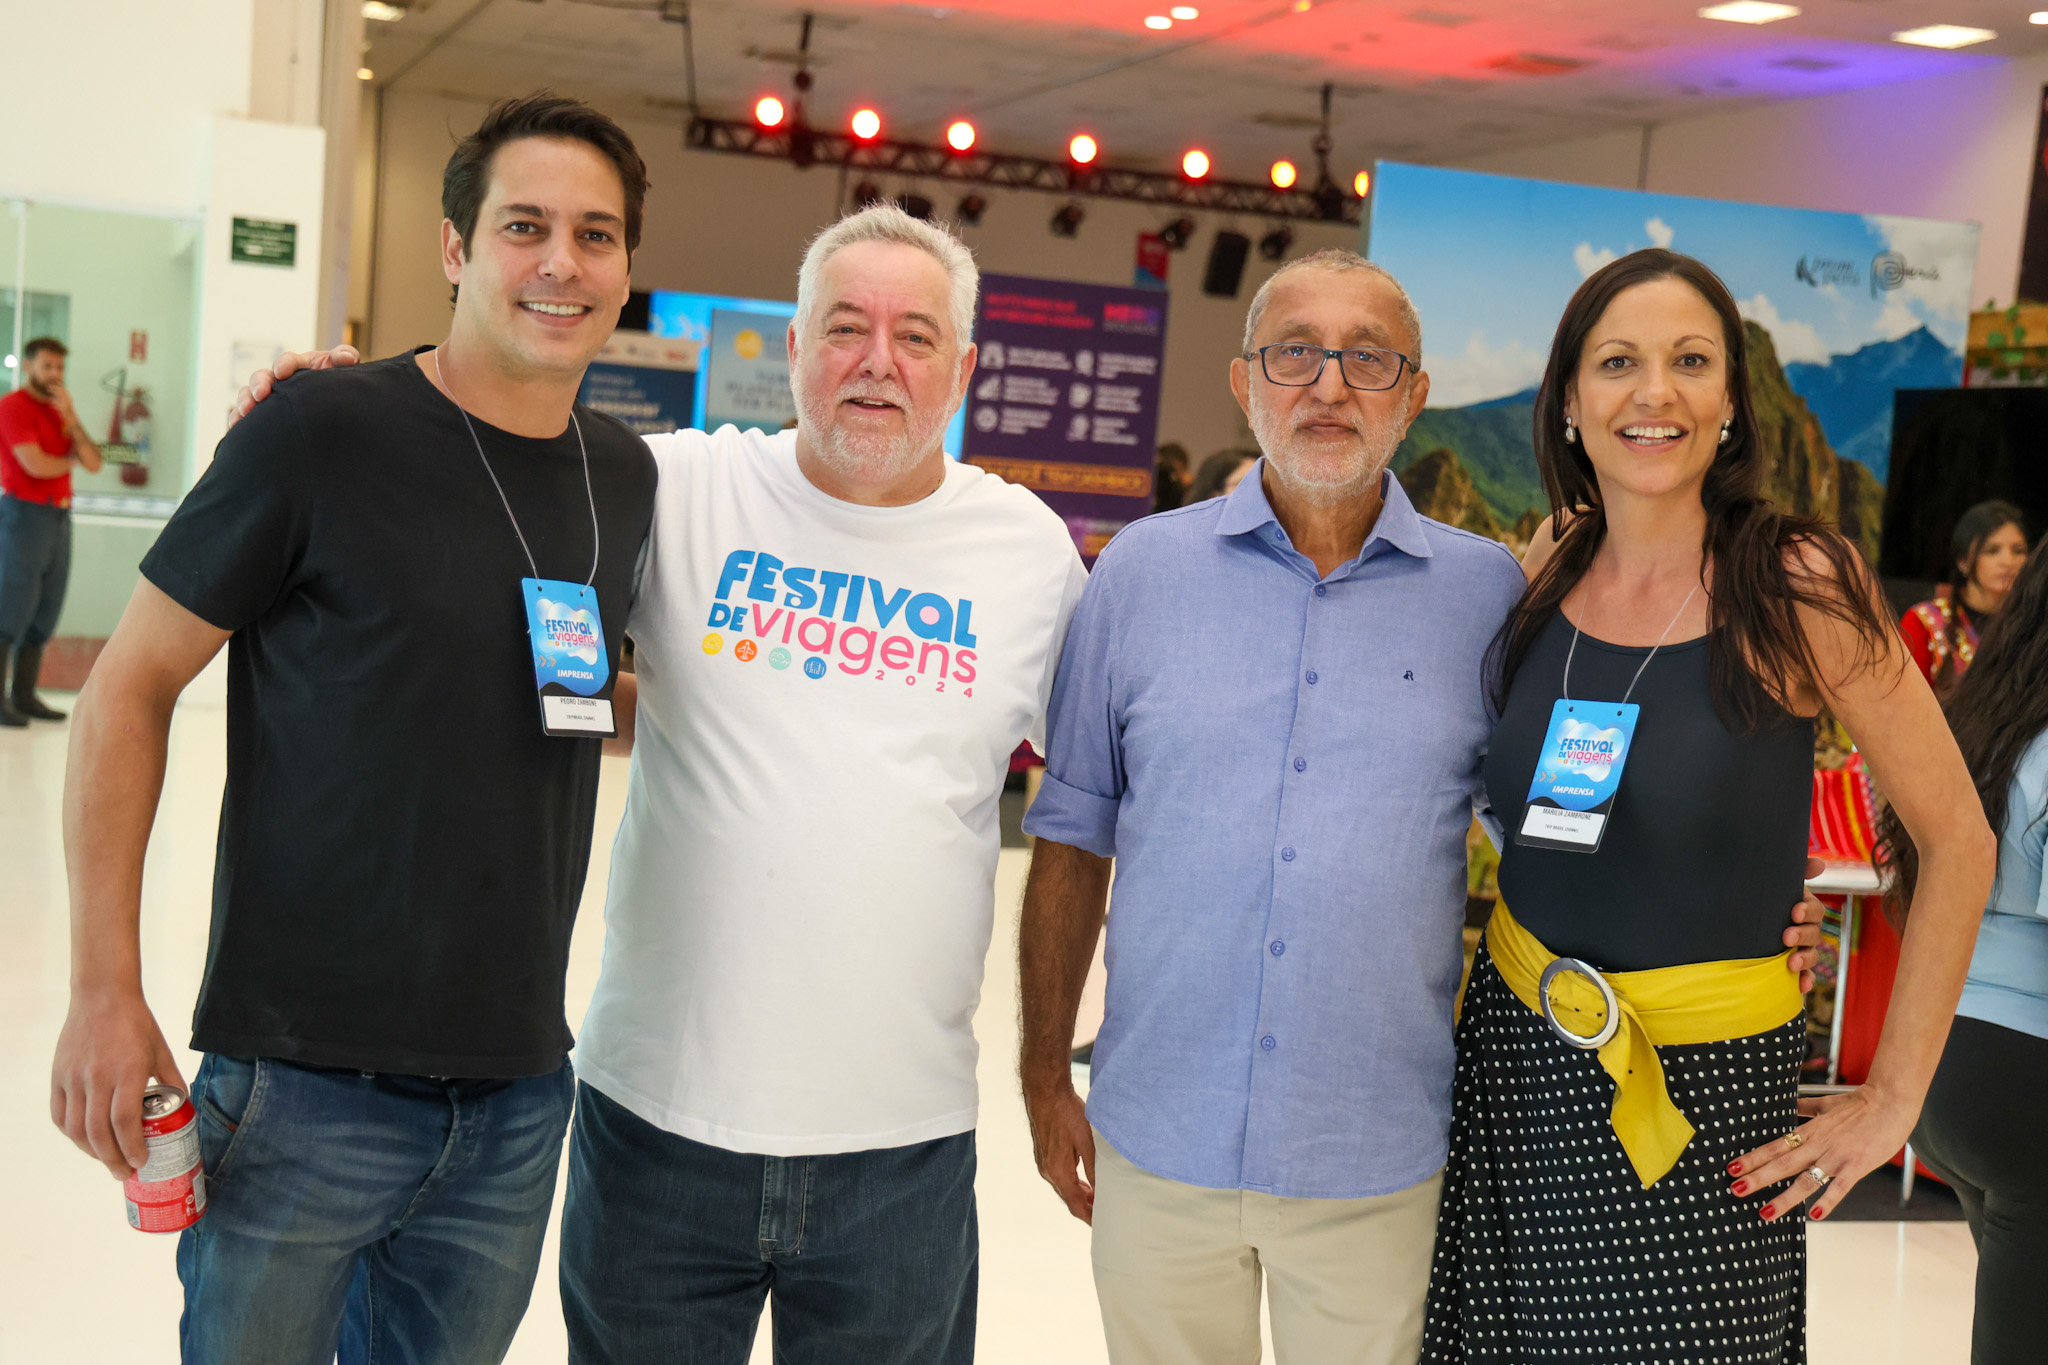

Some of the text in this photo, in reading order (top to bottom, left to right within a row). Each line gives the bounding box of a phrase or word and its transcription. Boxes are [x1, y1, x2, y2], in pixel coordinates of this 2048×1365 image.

[715, 549, 977, 649] FESTIVAL
[707, 602, 749, 632] DE
[546, 619, 592, 635] FESTIVAL
[557, 670, 594, 680] IMPRENSA
[1560, 738, 1614, 753] FESTIVAL
[1552, 785, 1595, 796] IMPRENSA
[1542, 808, 1563, 817] MARILIA
